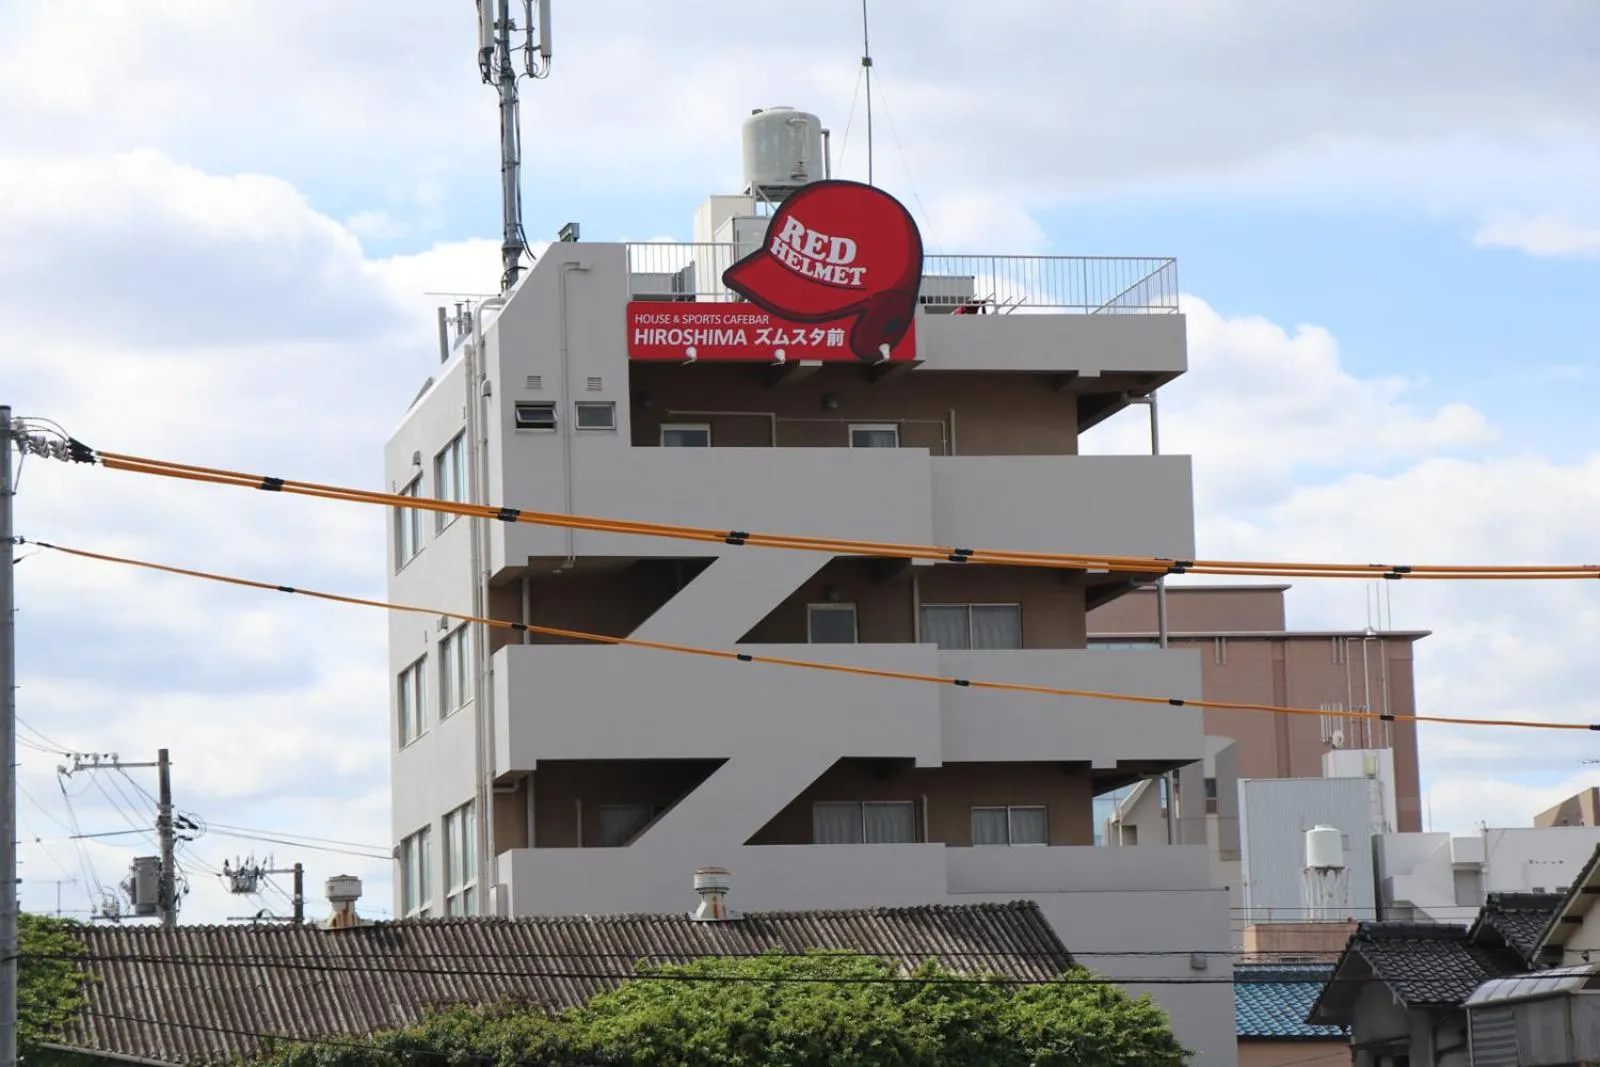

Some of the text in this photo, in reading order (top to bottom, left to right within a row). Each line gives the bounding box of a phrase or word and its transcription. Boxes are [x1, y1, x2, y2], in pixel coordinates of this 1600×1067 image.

[779, 215, 857, 265] RED
[770, 236, 867, 286] HELMET
[635, 314, 769, 325] HOUSE & SPORTS CAFEBAR
[634, 328, 845, 347] HIROSHIMA ズムスタ前
